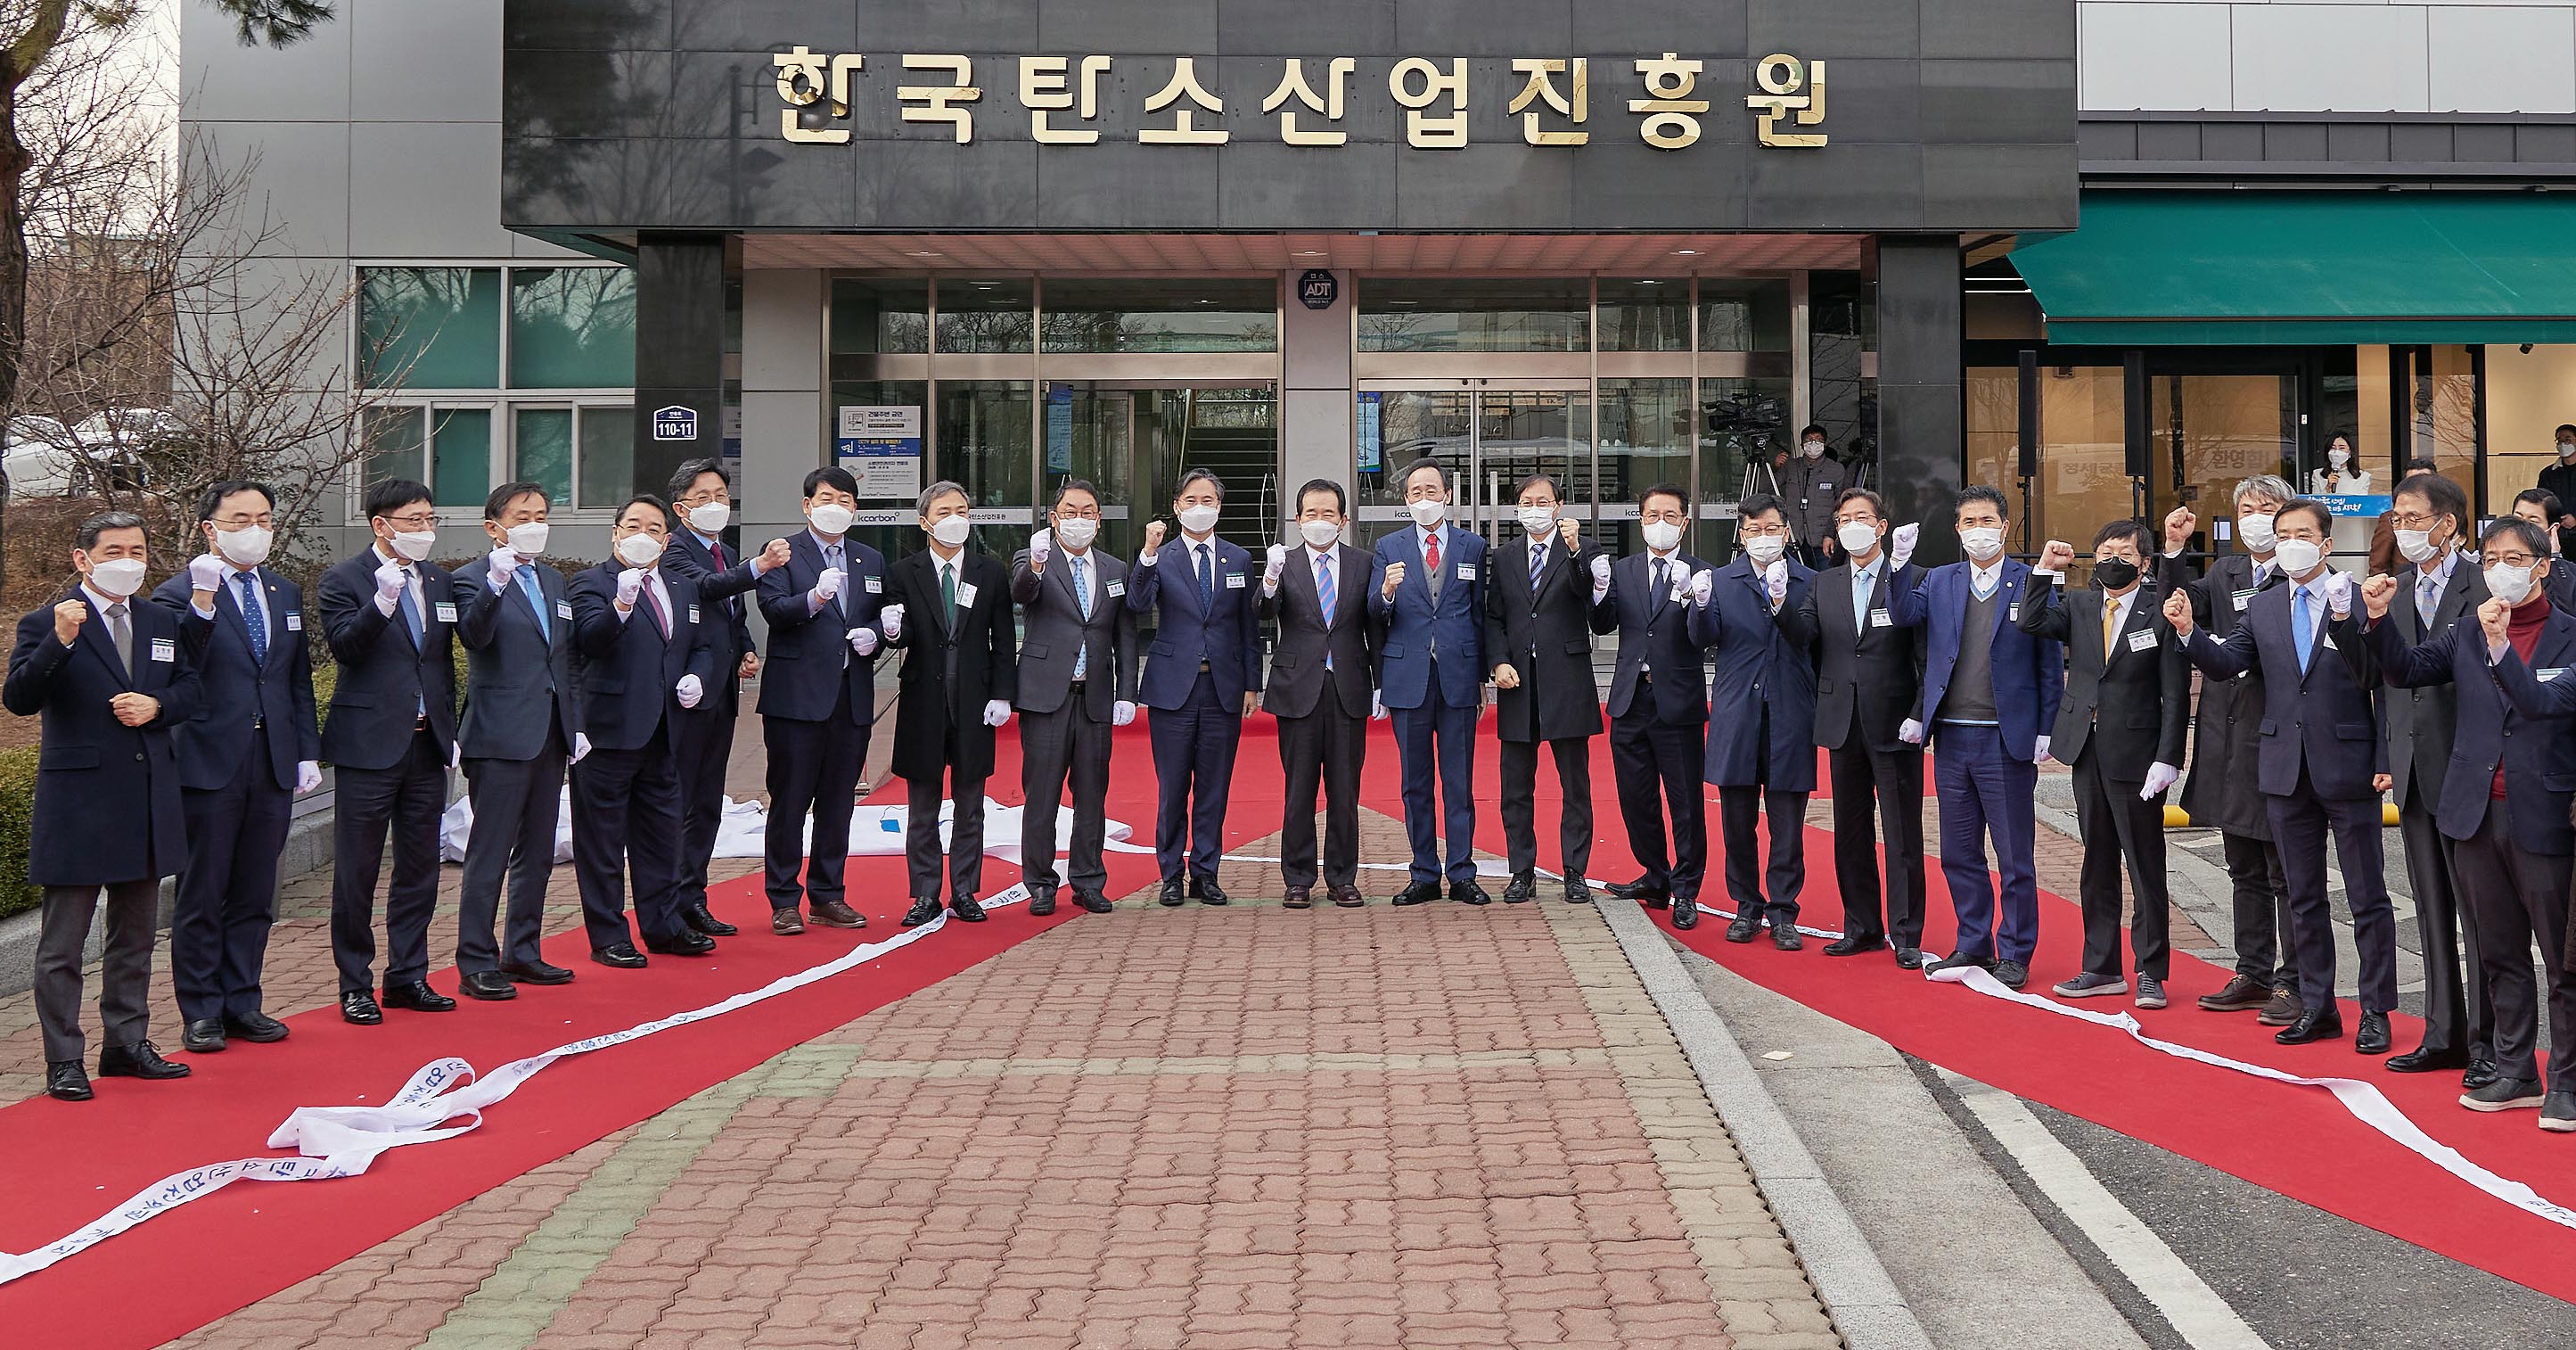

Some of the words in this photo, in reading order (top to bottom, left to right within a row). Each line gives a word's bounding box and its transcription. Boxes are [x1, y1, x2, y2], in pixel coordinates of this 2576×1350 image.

[775, 46, 1829, 149] 한국탄소산업진흥원
[1305, 283, 1331, 296] ADT
[658, 423, 692, 436] 110-11
